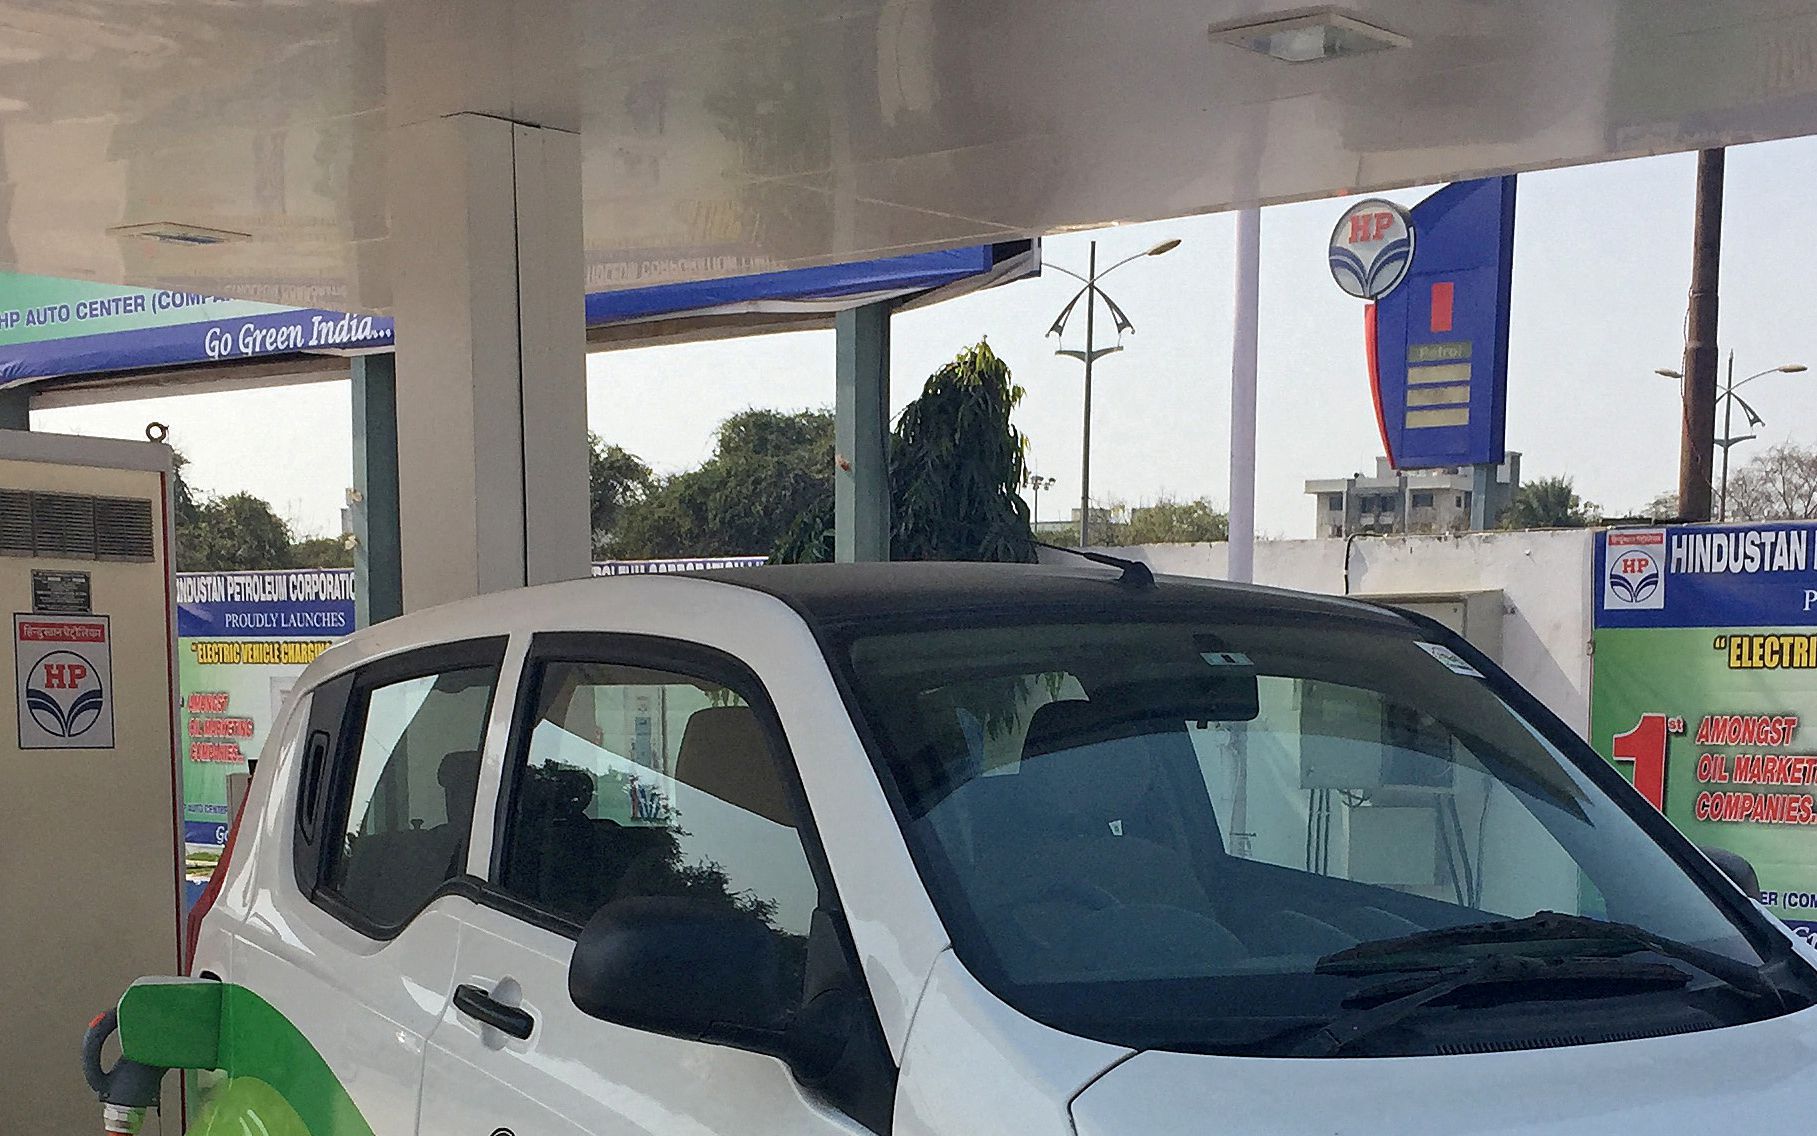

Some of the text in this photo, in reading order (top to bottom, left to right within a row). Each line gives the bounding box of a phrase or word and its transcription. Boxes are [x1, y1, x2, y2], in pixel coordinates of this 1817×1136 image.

[1349, 213, 1394, 243] HP
[26, 304, 70, 326] AUTO
[76, 295, 146, 320] CENTER
[205, 328, 232, 360] Go
[239, 319, 304, 356] Green
[1622, 558, 1650, 574] HP
[1671, 530, 1807, 573] HINDUSTAN
[227, 575, 287, 602] PETROLEUM
[225, 612, 346, 628] PROUDLY LAUNCHES
[241, 641, 279, 664] VEHICLE
[44, 664, 87, 688] HP
[1696, 716, 1798, 745] AMONGST
[1698, 754, 1729, 783] OIL
